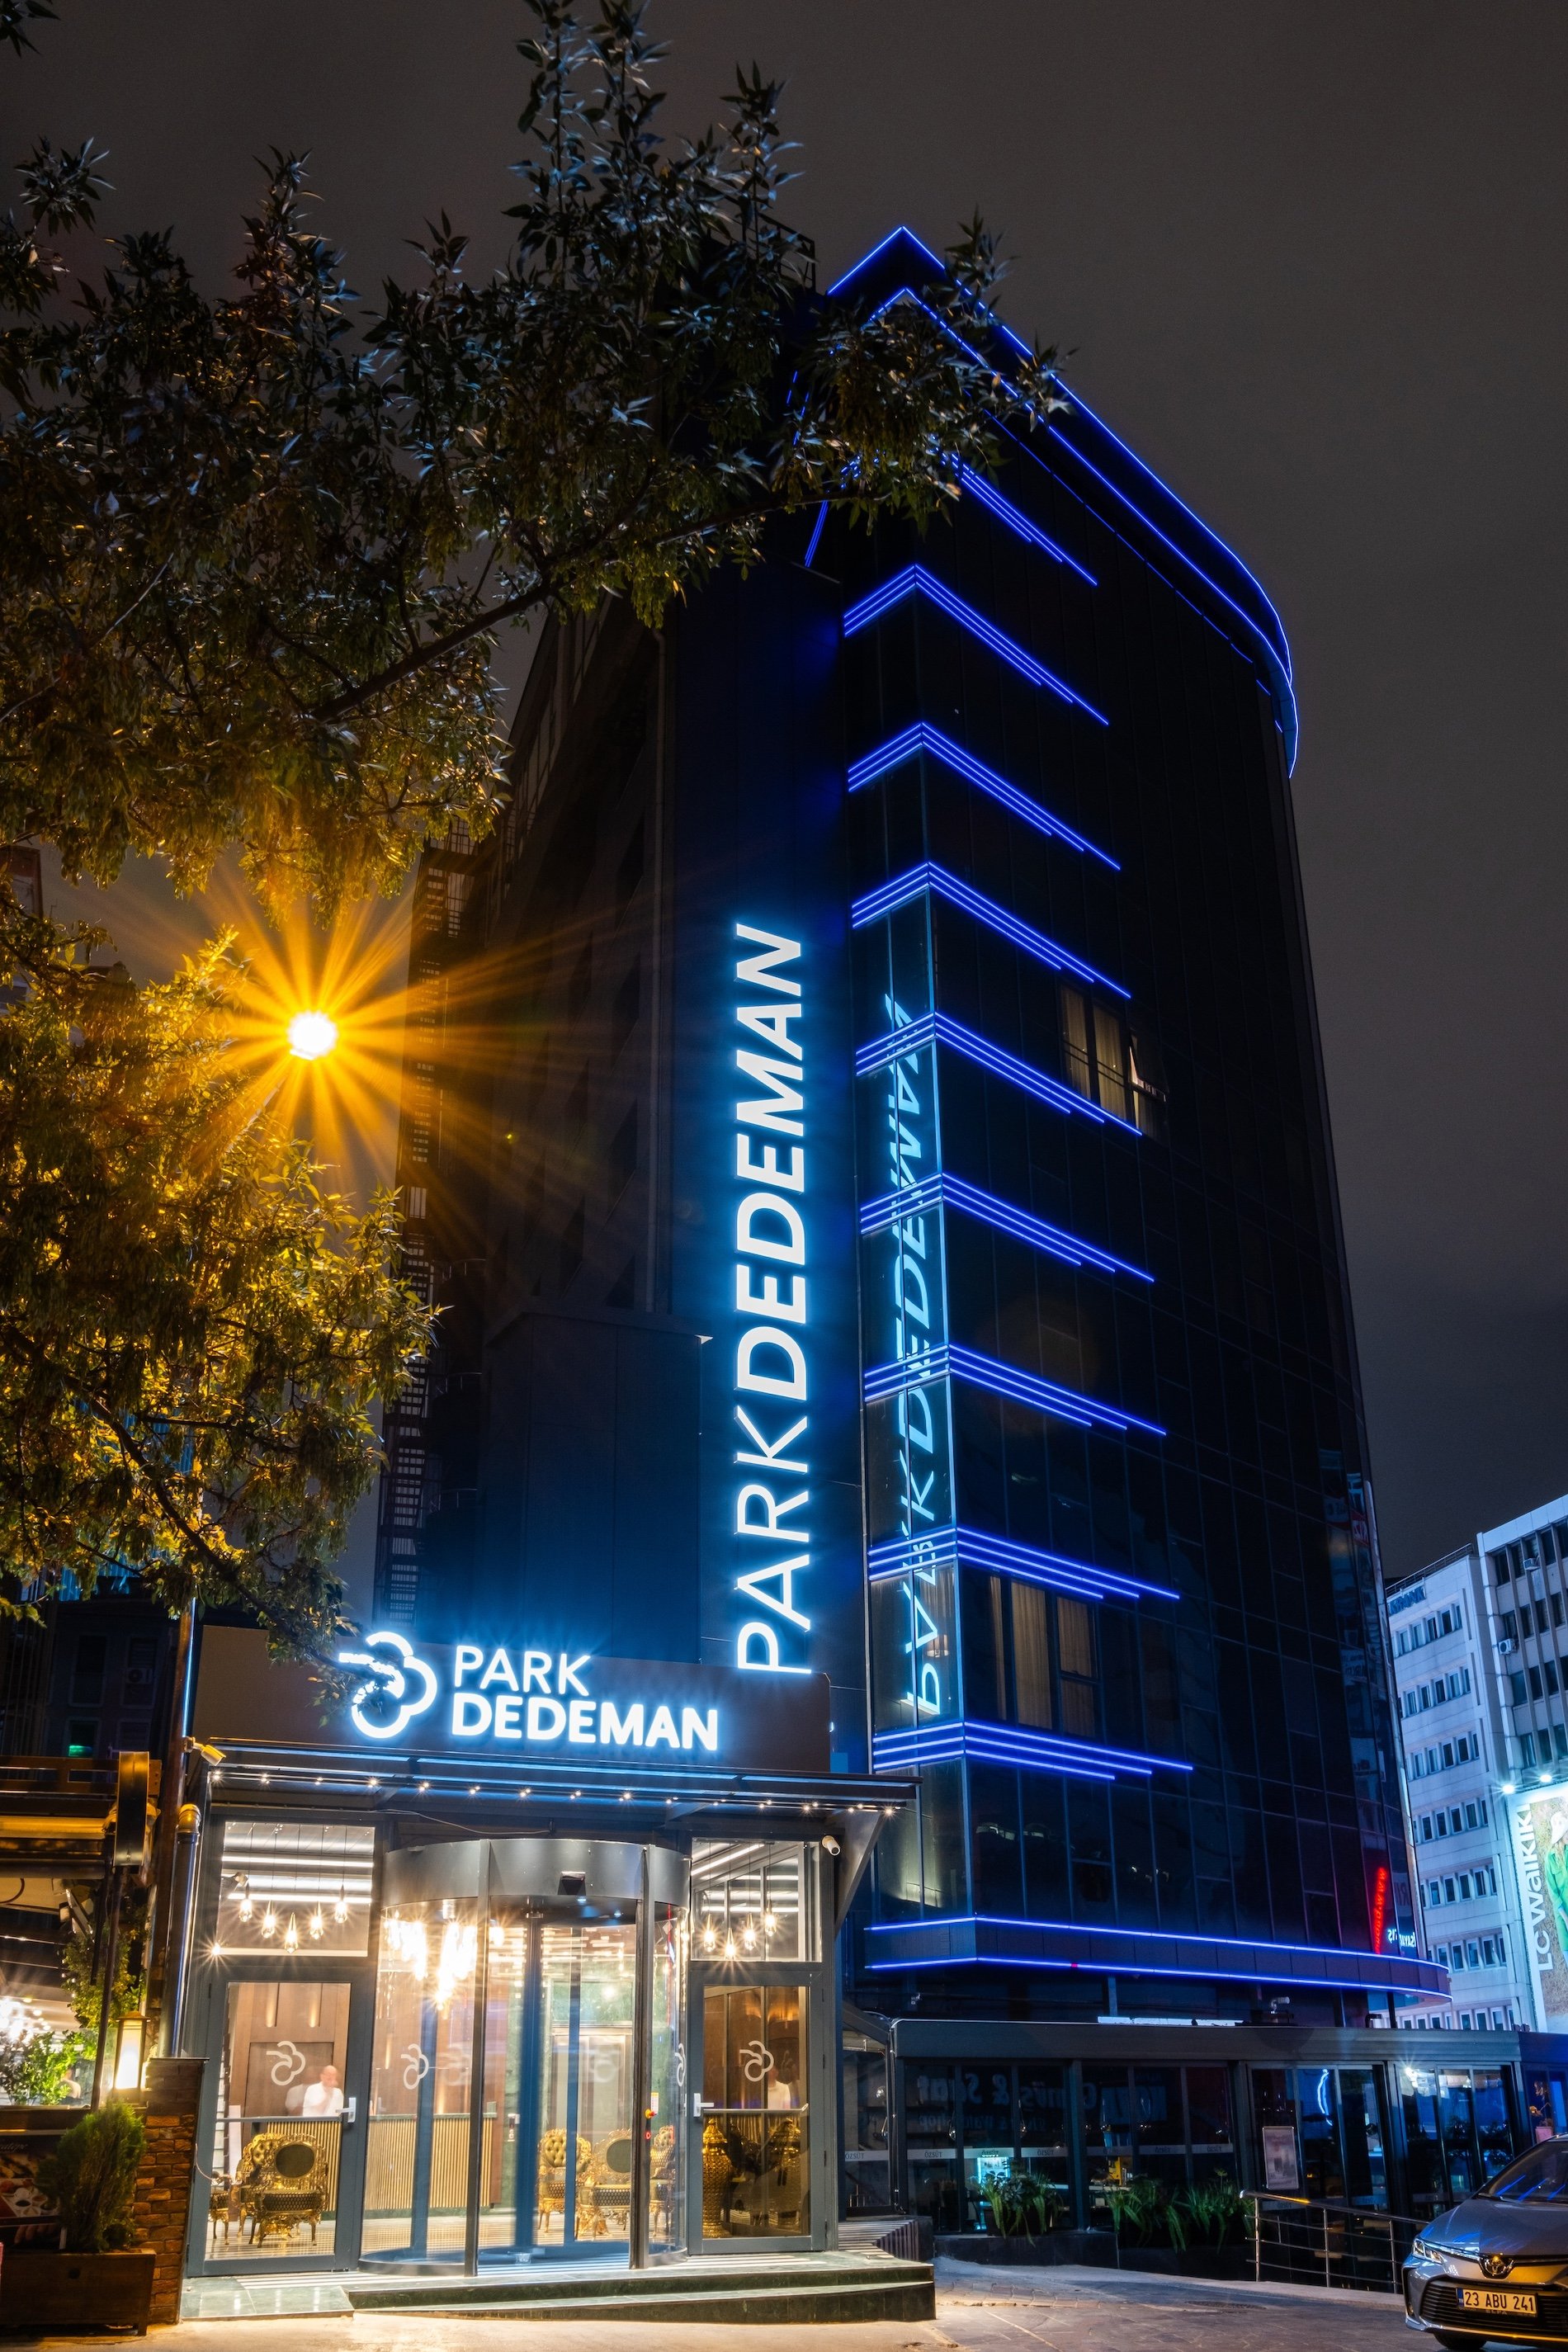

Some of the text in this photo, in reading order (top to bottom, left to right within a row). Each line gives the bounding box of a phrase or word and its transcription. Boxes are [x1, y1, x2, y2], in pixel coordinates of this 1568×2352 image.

[454, 1645, 591, 1697] PARK
[451, 1693, 719, 1751] DEDEMAN
[1534, 1929, 1554, 1972] LC
[1465, 2291, 1533, 2312] 23 ABU 241
